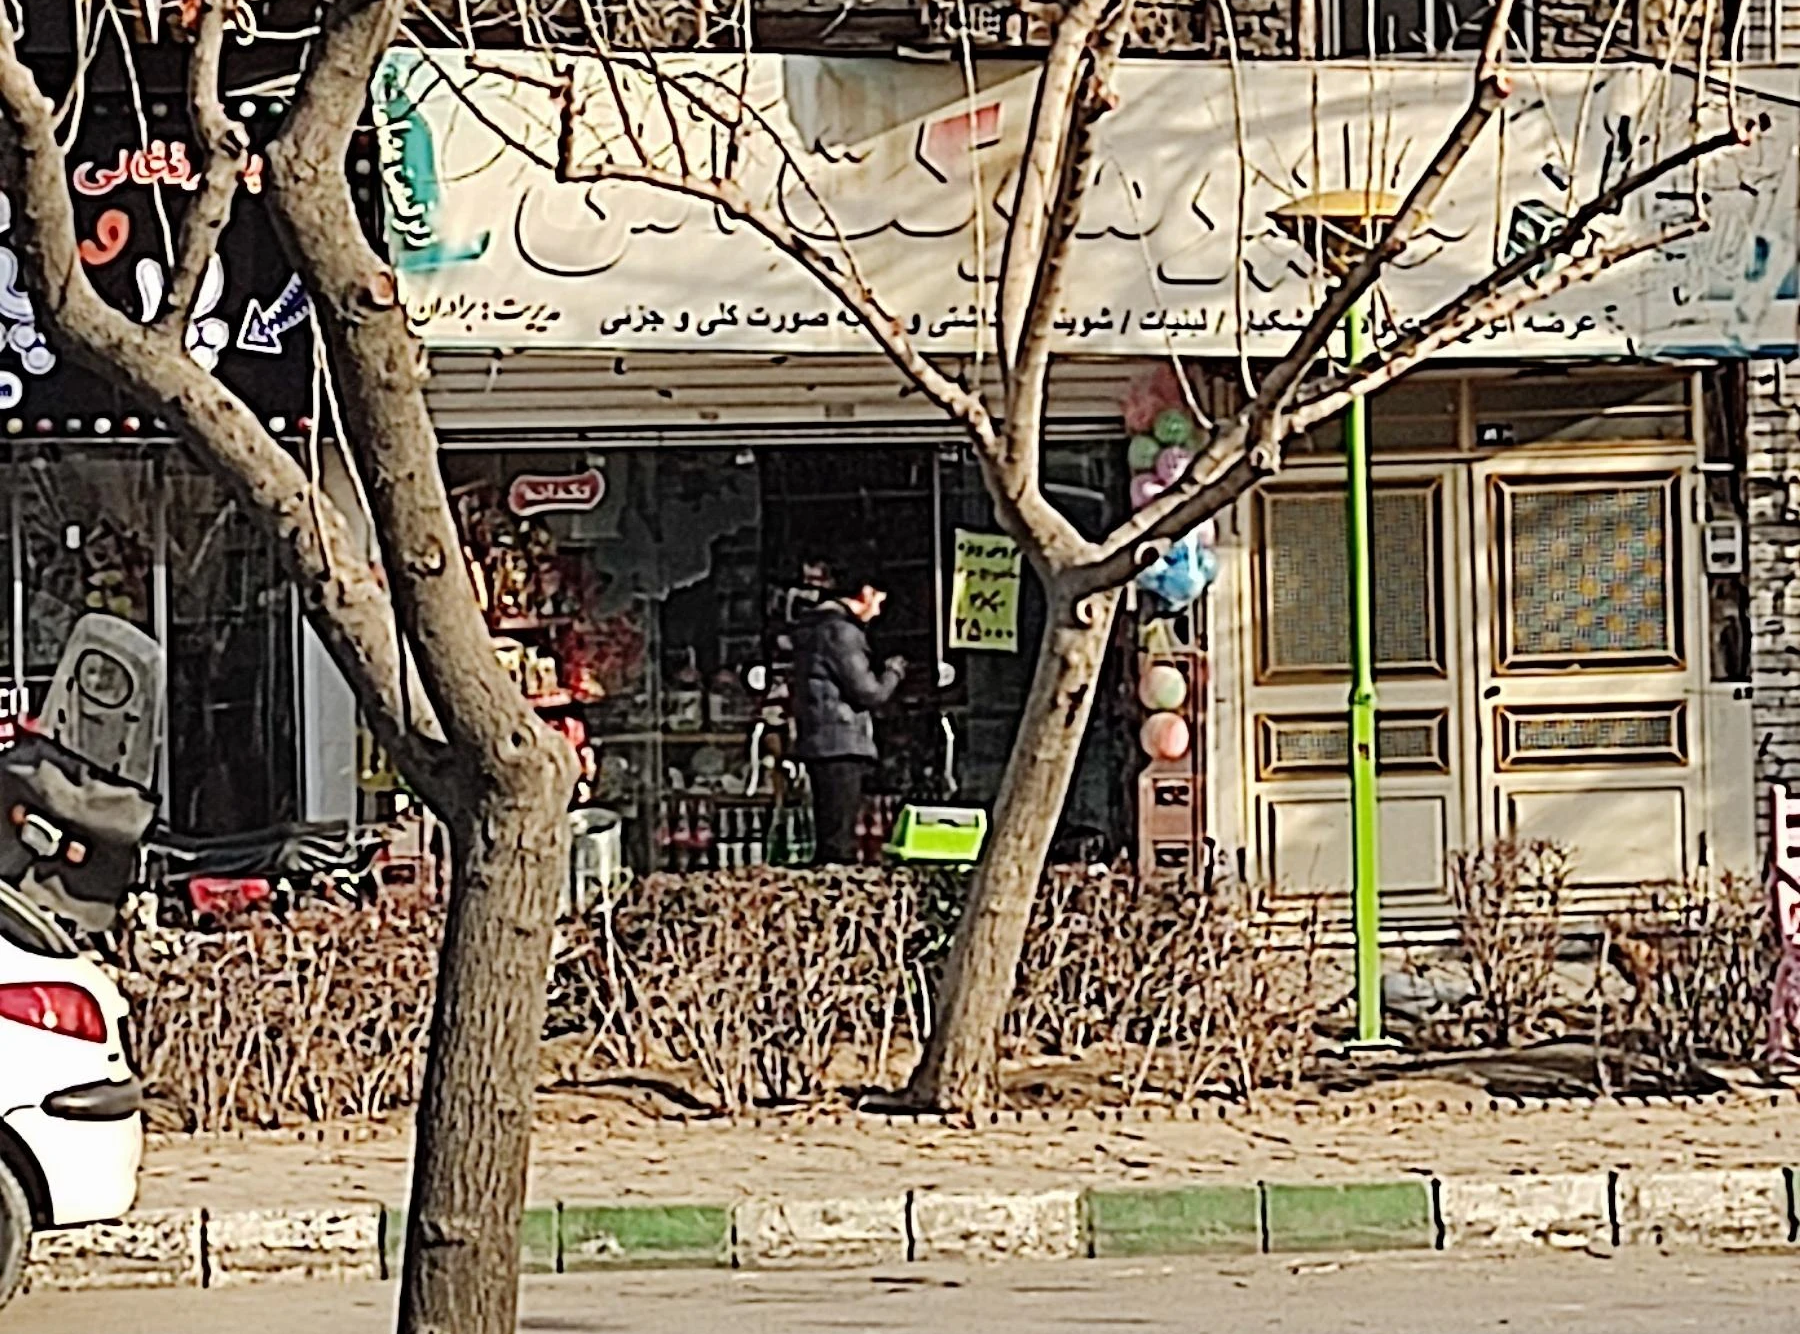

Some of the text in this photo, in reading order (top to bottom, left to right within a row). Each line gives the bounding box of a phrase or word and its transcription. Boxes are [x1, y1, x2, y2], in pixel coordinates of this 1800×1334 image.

[672, 312, 690, 332] و
[699, 302, 738, 335] کلی
[746, 306, 829, 333] صورت
[1139, 307, 1207, 337] لبنیات
[1523, 310, 1596, 340] عرضه
